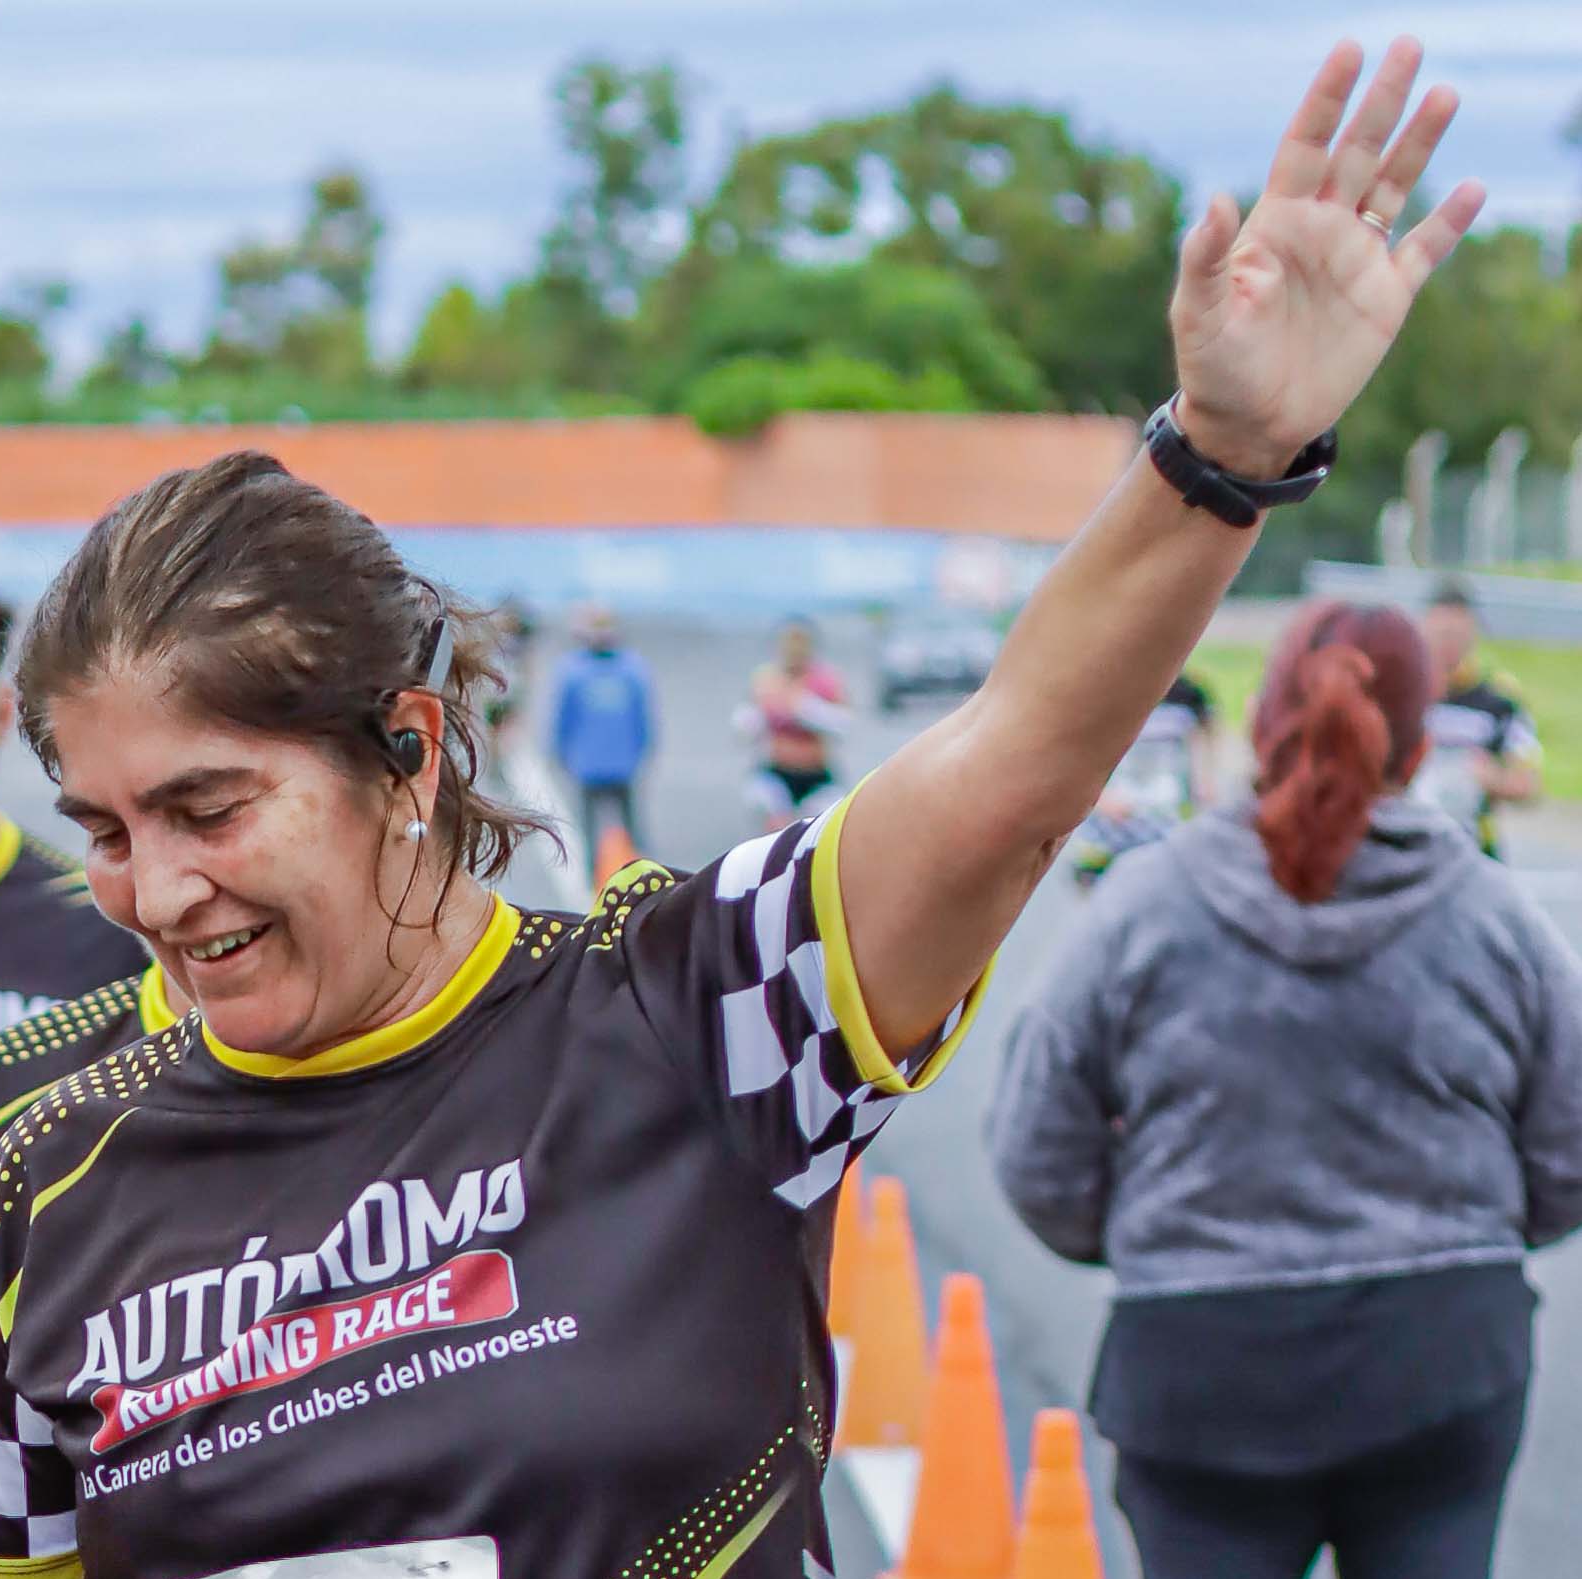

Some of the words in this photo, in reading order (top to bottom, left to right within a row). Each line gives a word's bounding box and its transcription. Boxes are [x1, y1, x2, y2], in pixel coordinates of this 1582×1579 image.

[94, 1448, 172, 1494] Carrera
[175, 1434, 215, 1468] de
[219, 1422, 264, 1454] los
[267, 1377, 372, 1435] Clubes
[375, 1358, 427, 1397] del
[429, 1313, 579, 1377] Noroeste
[119, 1317, 318, 1432] RUNNING
